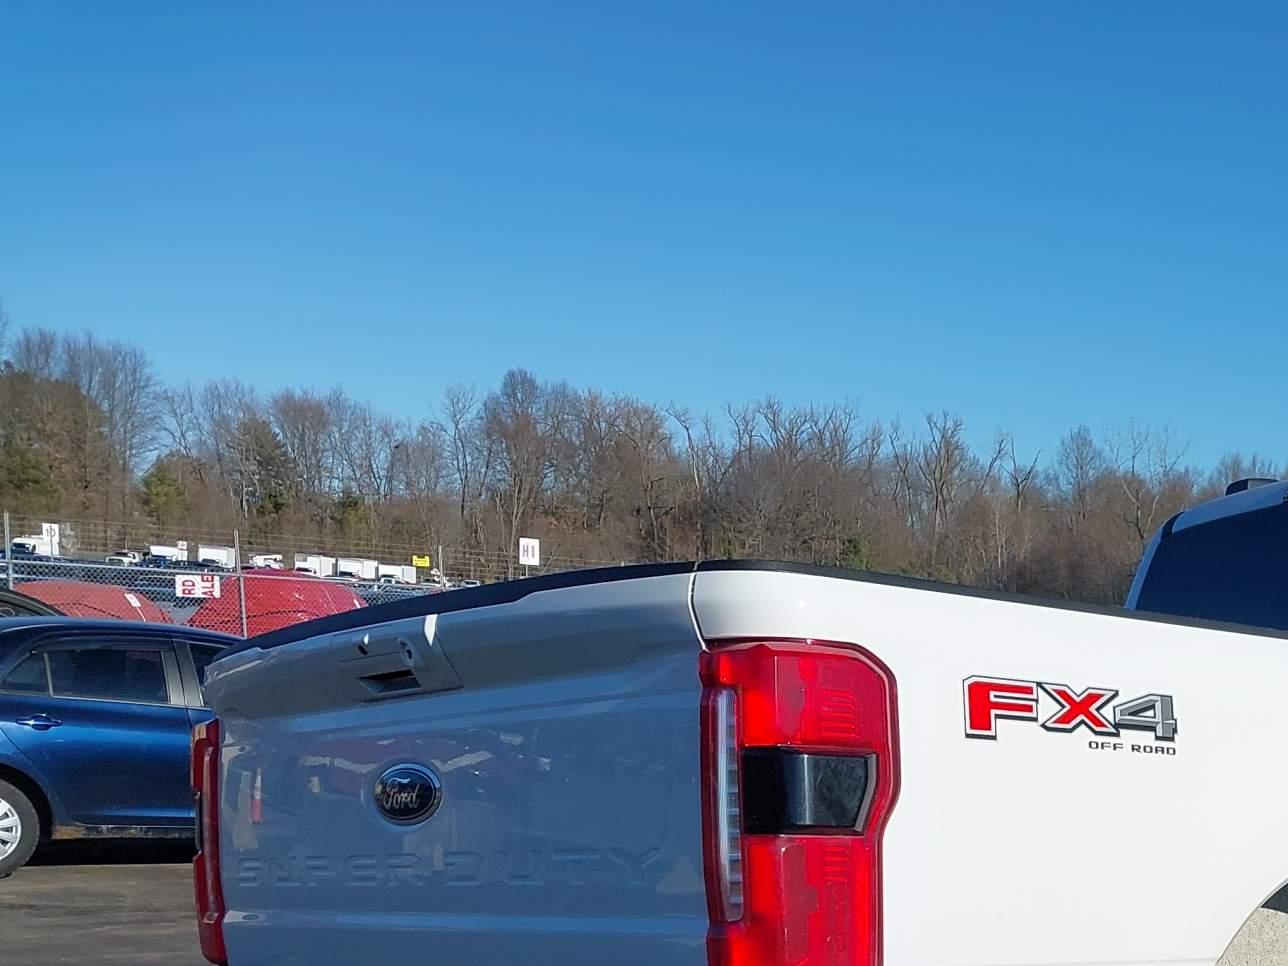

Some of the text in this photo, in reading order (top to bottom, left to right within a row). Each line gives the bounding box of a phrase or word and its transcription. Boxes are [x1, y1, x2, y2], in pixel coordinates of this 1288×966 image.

[182, 579, 196, 596] RD
[963, 675, 1178, 742] FX4
[1088, 740, 1177, 756] OFF ROAD
[383, 777, 420, 810] Ford
[237, 845, 664, 888] SUPER DUTY
